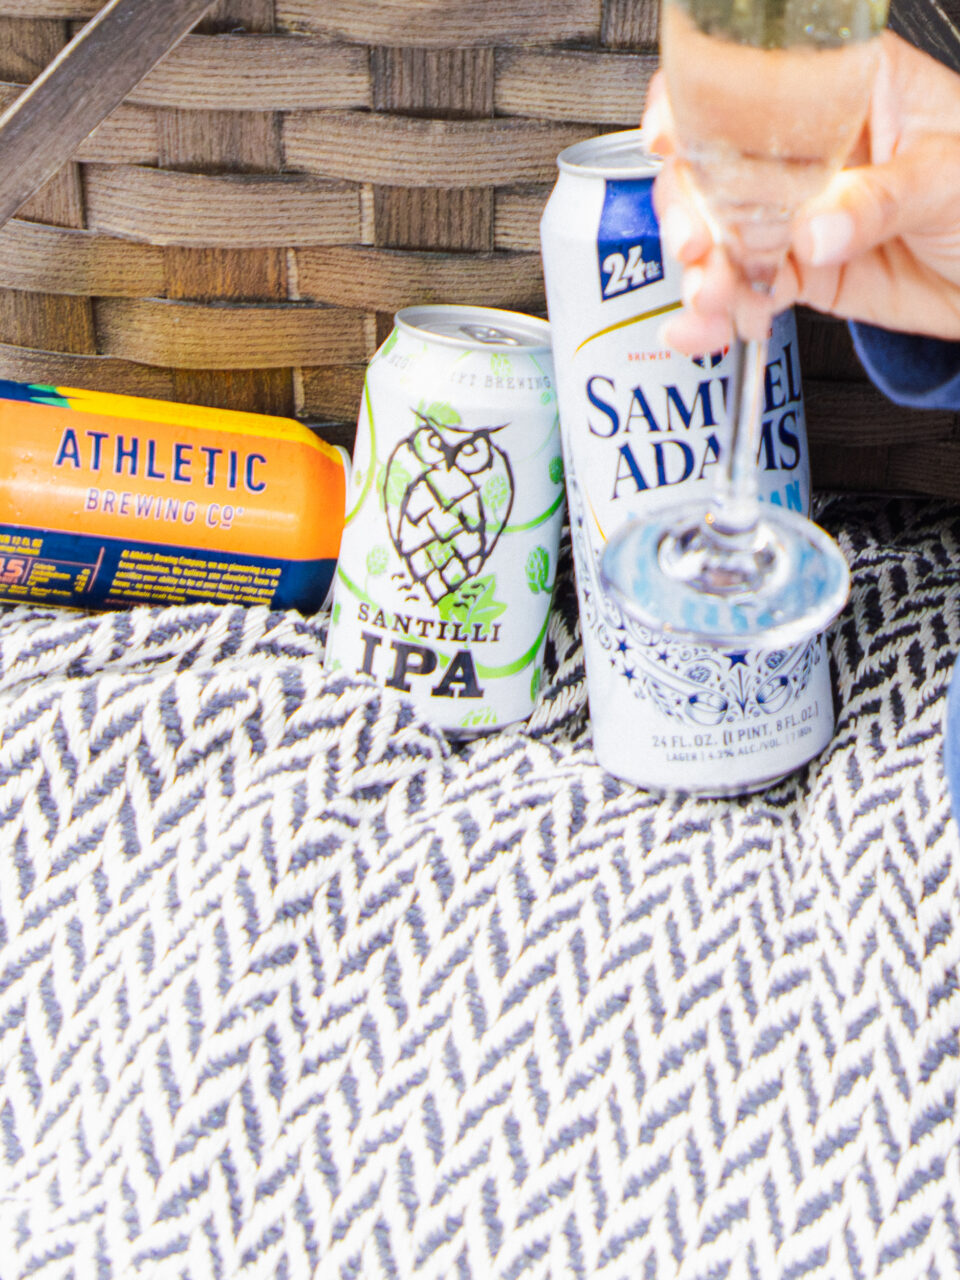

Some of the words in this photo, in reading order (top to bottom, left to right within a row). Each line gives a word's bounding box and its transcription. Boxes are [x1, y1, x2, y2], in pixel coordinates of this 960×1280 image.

[484, 375, 552, 390] BREWING
[55, 427, 267, 493] ATHLETIC
[84, 488, 197, 524] BREWING
[357, 602, 501, 643] SANTILLI
[356, 630, 485, 699] IPA
